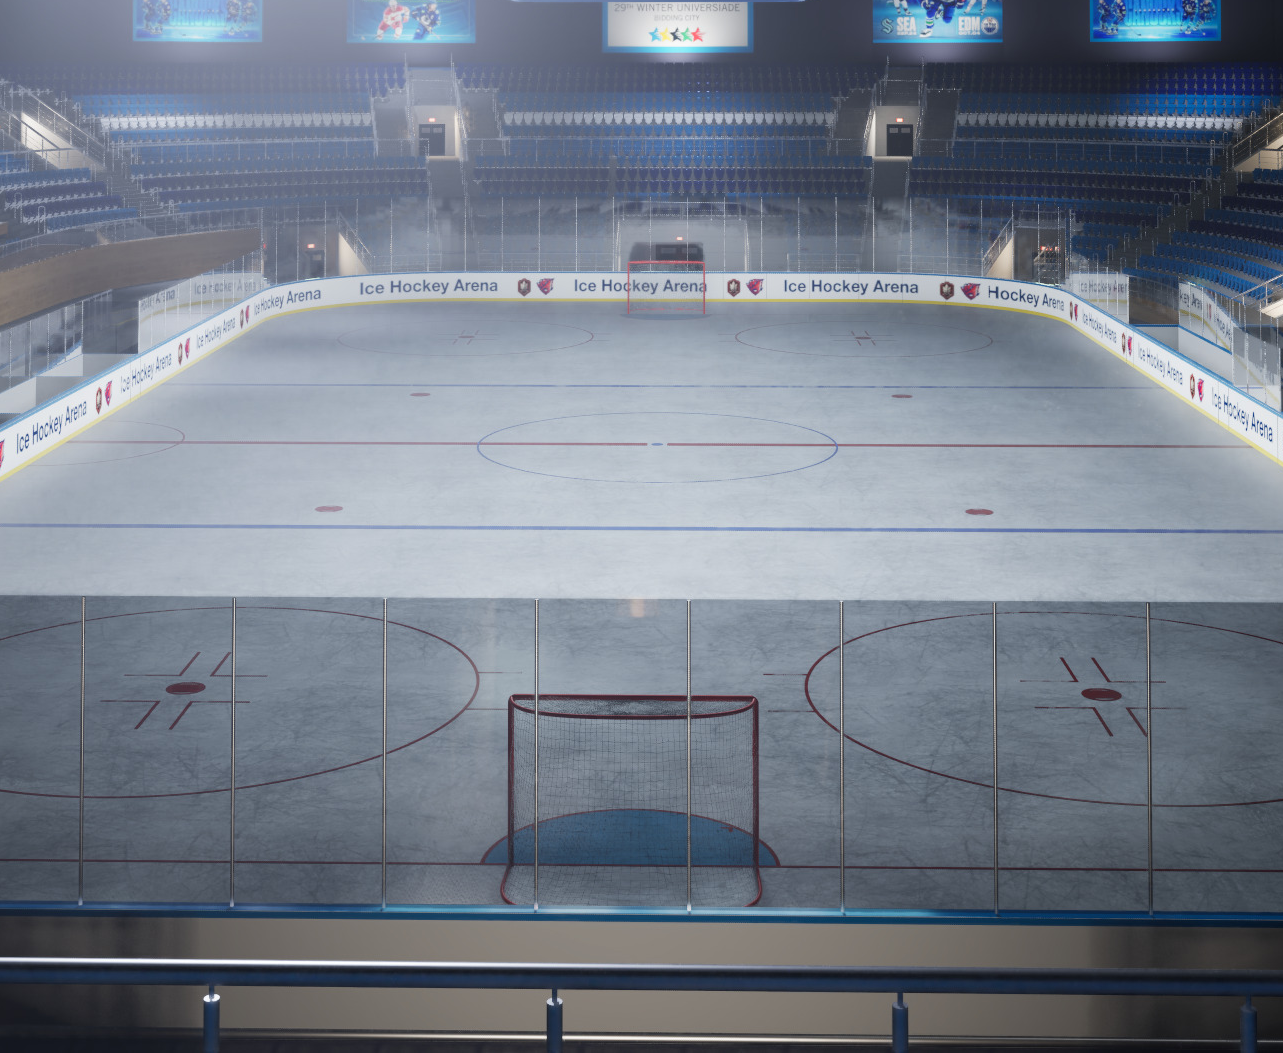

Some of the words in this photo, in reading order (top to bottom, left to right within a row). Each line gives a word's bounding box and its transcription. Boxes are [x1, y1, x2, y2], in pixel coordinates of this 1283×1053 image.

[637, 3, 674, 12] WINTER
[677, 3, 741, 12] UNIVERSIADE
[896, 16, 917, 31] SEA
[958, 16, 981, 31] EDM
[360, 282, 376, 295] Ice
[390, 279, 449, 296] Hockey
[453, 278, 498, 292] Arena
[574, 279, 597, 292] Ice
[602, 279, 657, 295] Hockey
[663, 279, 707, 292] Arena
[784, 279, 806, 293] Ice
[812, 279, 870, 296] Hockey
[874, 279, 918, 294] Arena
[988, 286, 1039, 307] Hockey
[1042, 293, 1064, 311] Arena
[261, 294, 284, 312] Hockey
[287, 289, 321, 304] Arena
[204, 322, 224, 346] Hockey
[223, 317, 236, 335] Arena
[132, 362, 154, 388] Hockey
[155, 351, 172, 373] Arena
[1146, 347, 1166, 377] Hockey
[1167, 360, 1183, 386] Arena
[1211, 387, 1222, 409] Ice
[1224, 394, 1250, 431] Hockey
[1251, 412, 1273, 442] Arena
[16, 433, 30, 454] Ice
[32, 414, 63, 446] Hockey
[65, 399, 87, 426] Arena
